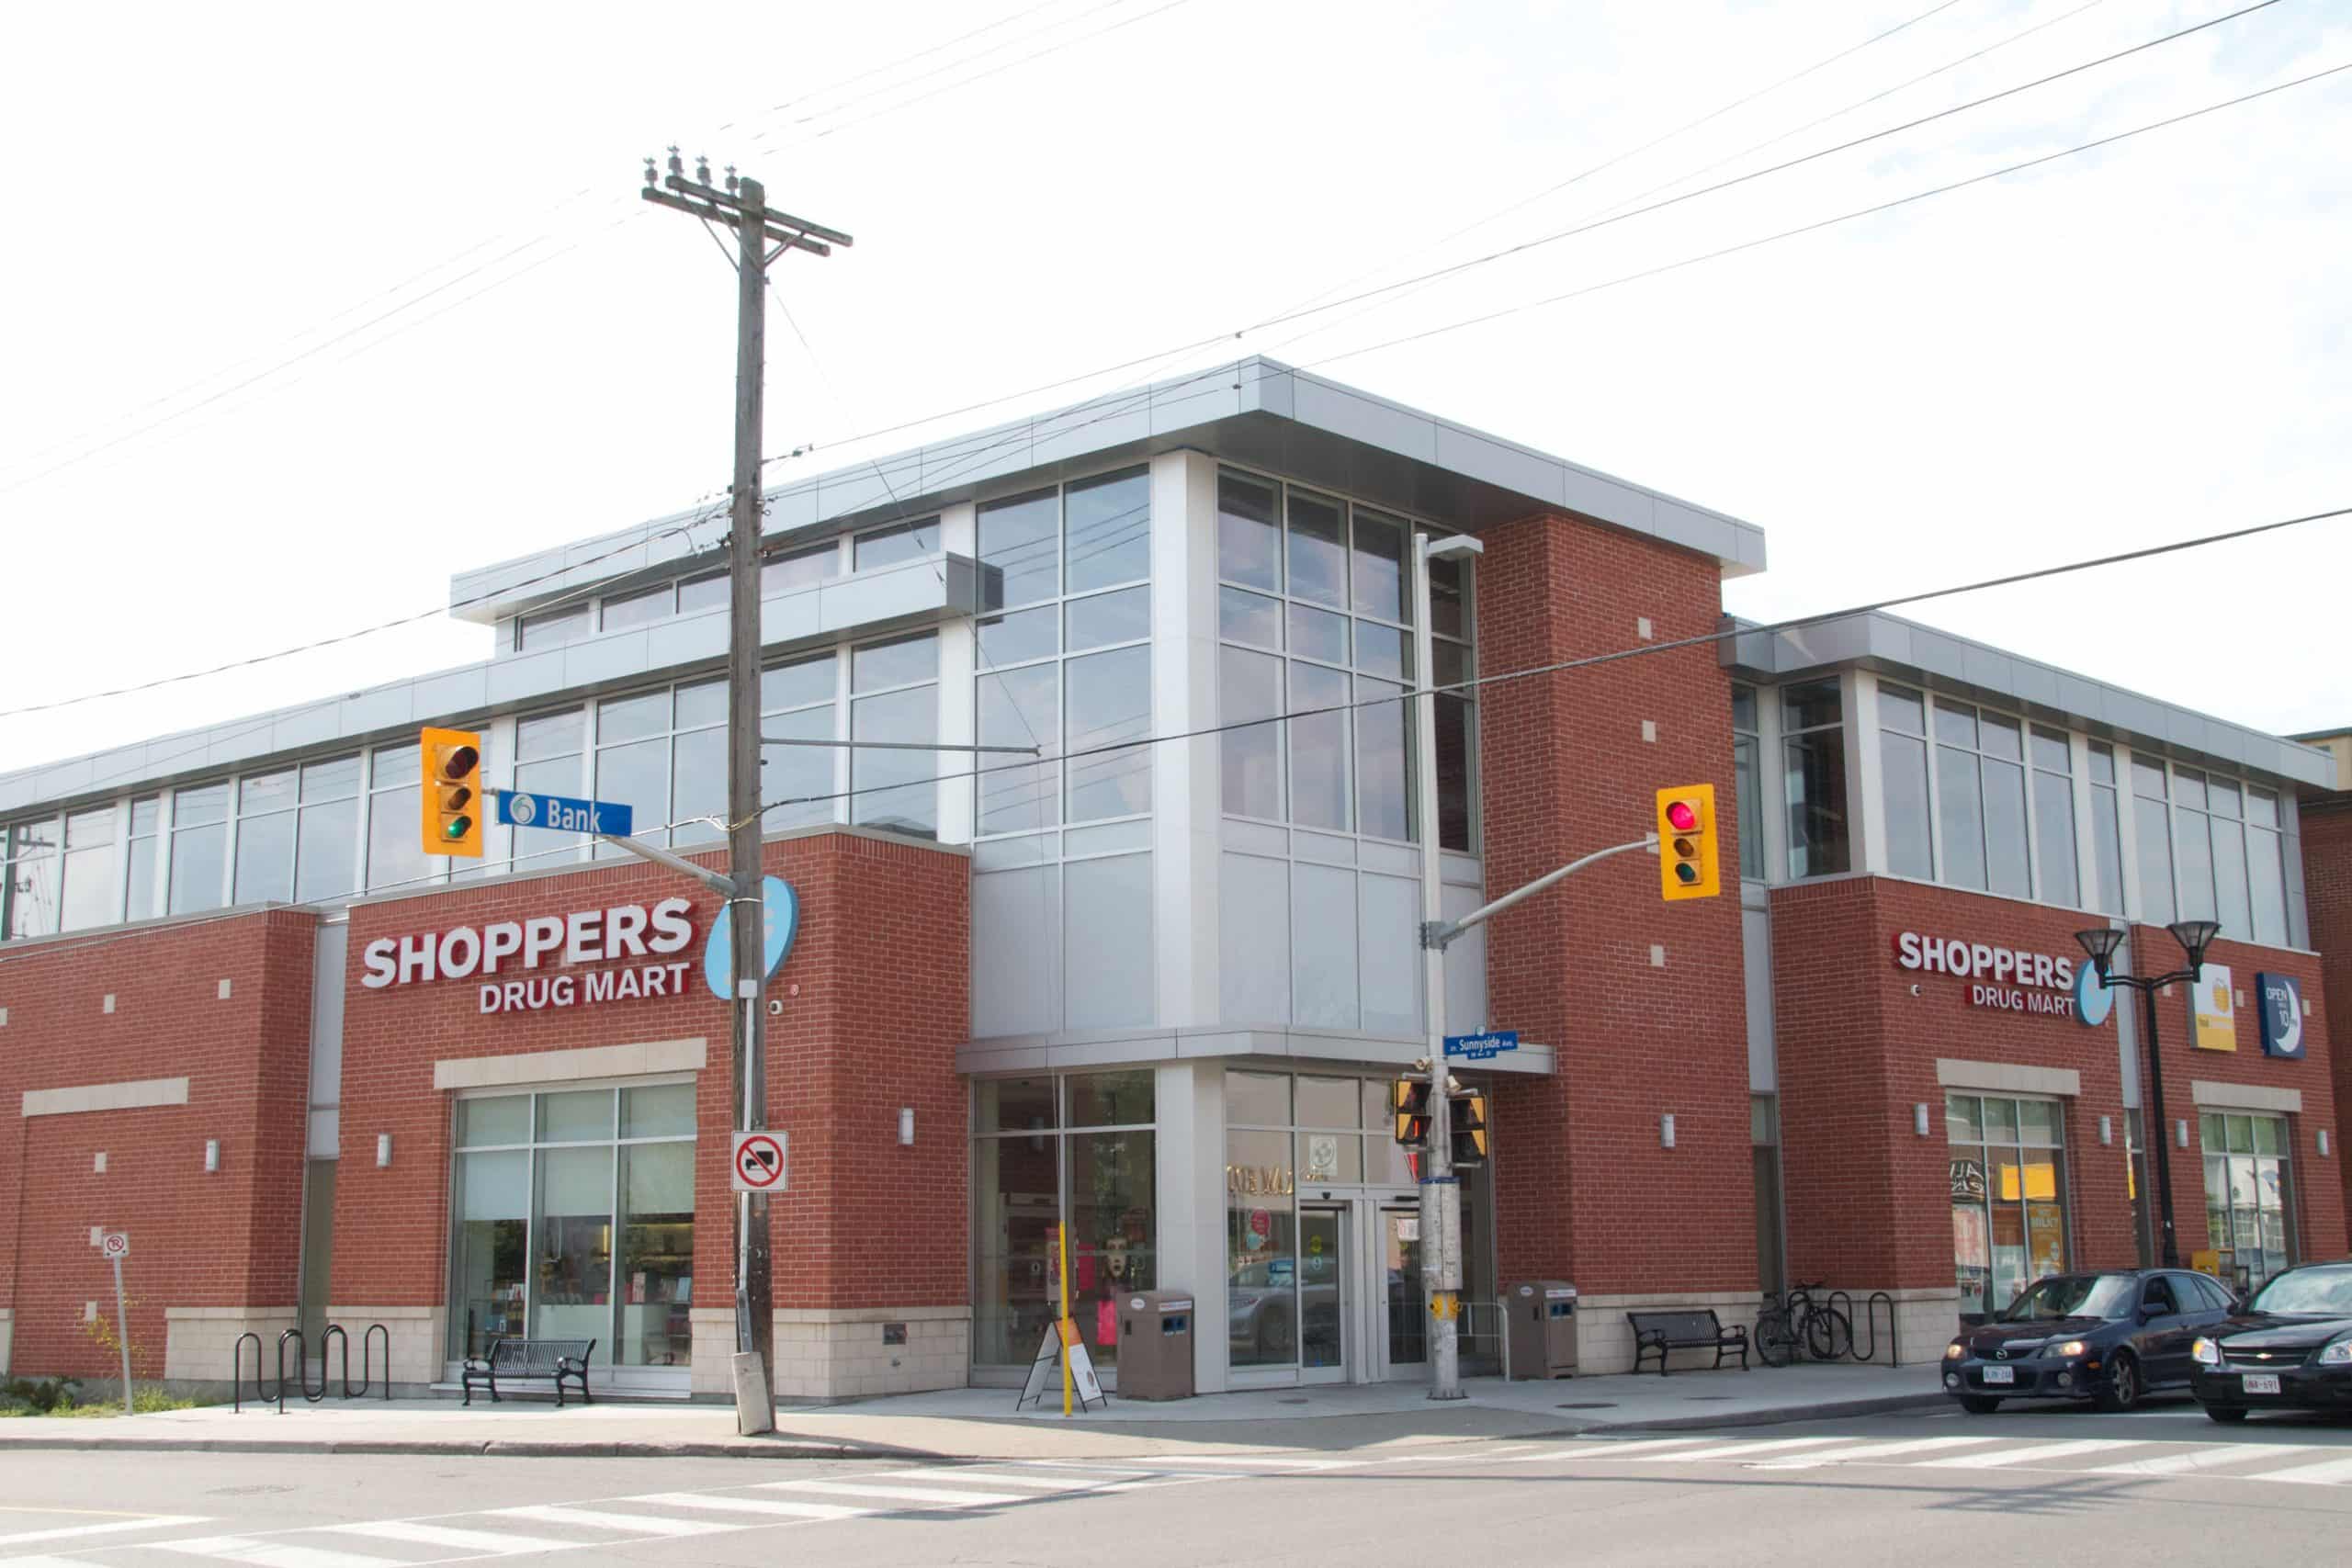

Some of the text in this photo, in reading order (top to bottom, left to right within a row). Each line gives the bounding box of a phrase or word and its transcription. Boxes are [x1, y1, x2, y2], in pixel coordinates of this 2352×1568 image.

[548, 798, 602, 832] Bank
[361, 897, 693, 988] SHOPPERS
[1899, 931, 2074, 991] SHOPPERS
[480, 962, 689, 1014] DRUG MART
[1973, 985, 2075, 1016] DRUG MART
[2266, 987, 2287, 1000] OPEN
[1459, 1035, 1500, 1053] Sunnyside
